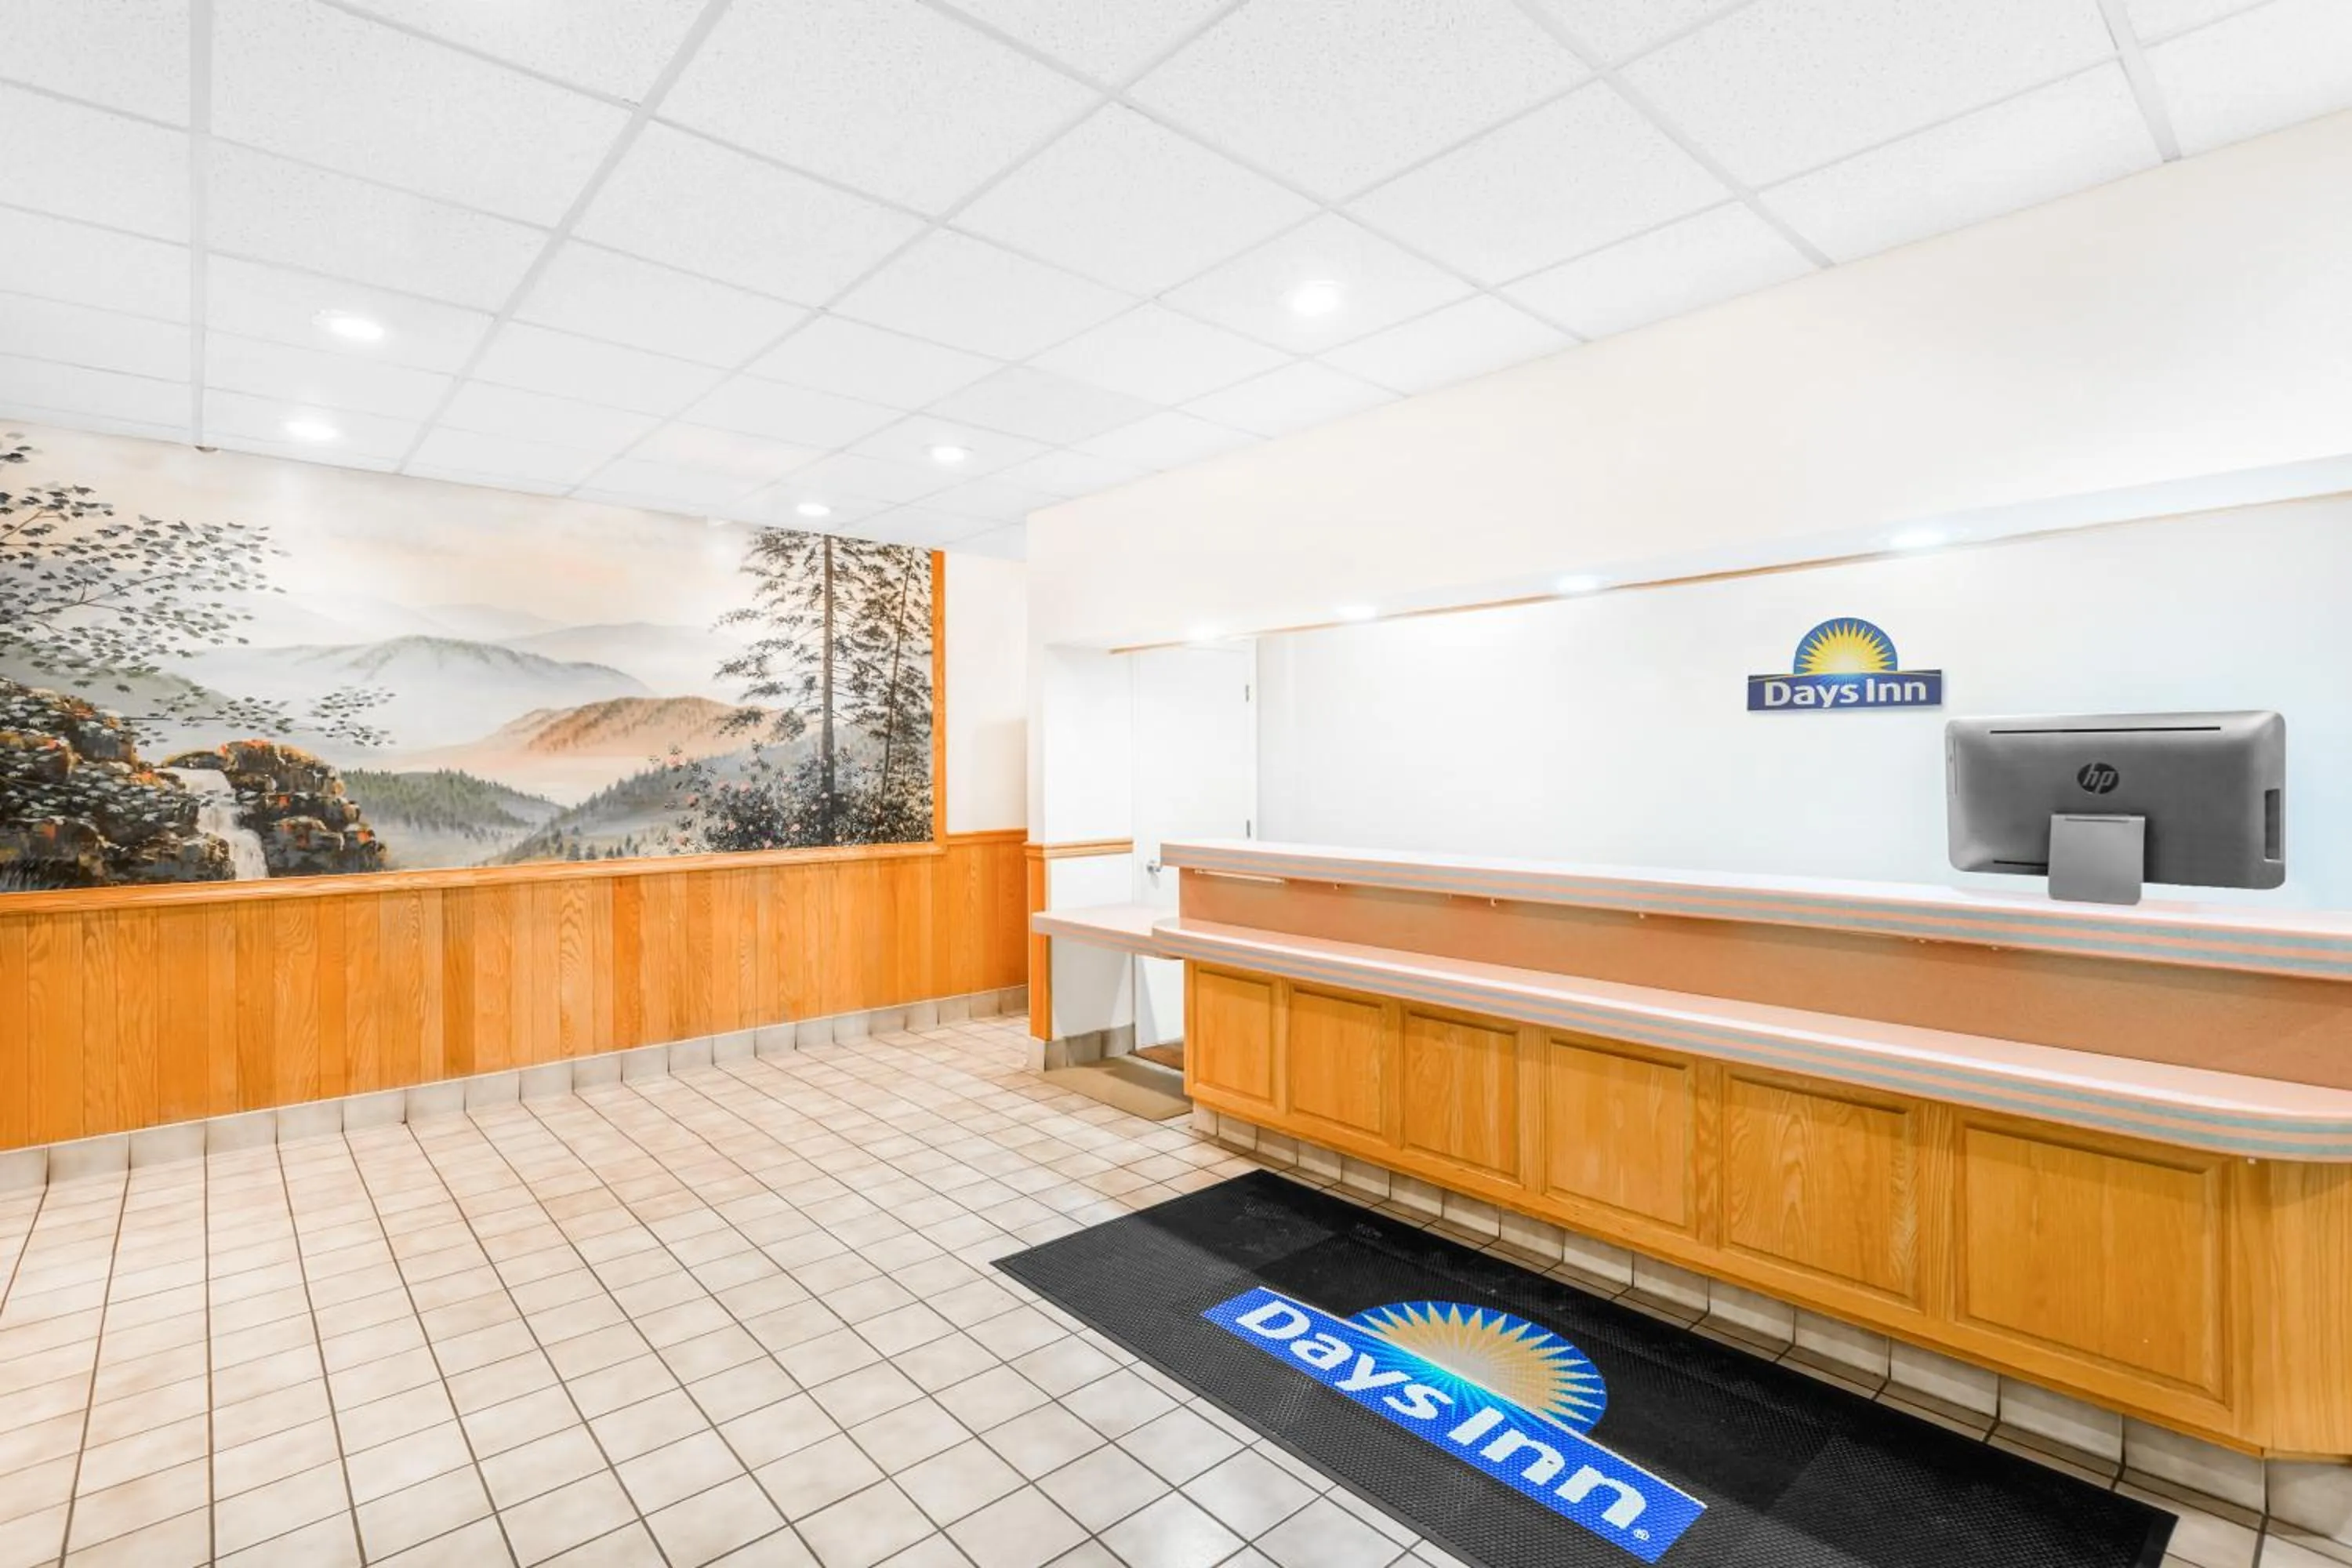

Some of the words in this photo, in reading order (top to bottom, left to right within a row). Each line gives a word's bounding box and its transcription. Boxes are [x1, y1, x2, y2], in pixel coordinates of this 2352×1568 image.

[1764, 681, 1859, 707] Days
[1866, 678, 1926, 702] Inn
[1235, 1301, 1454, 1420] Days
